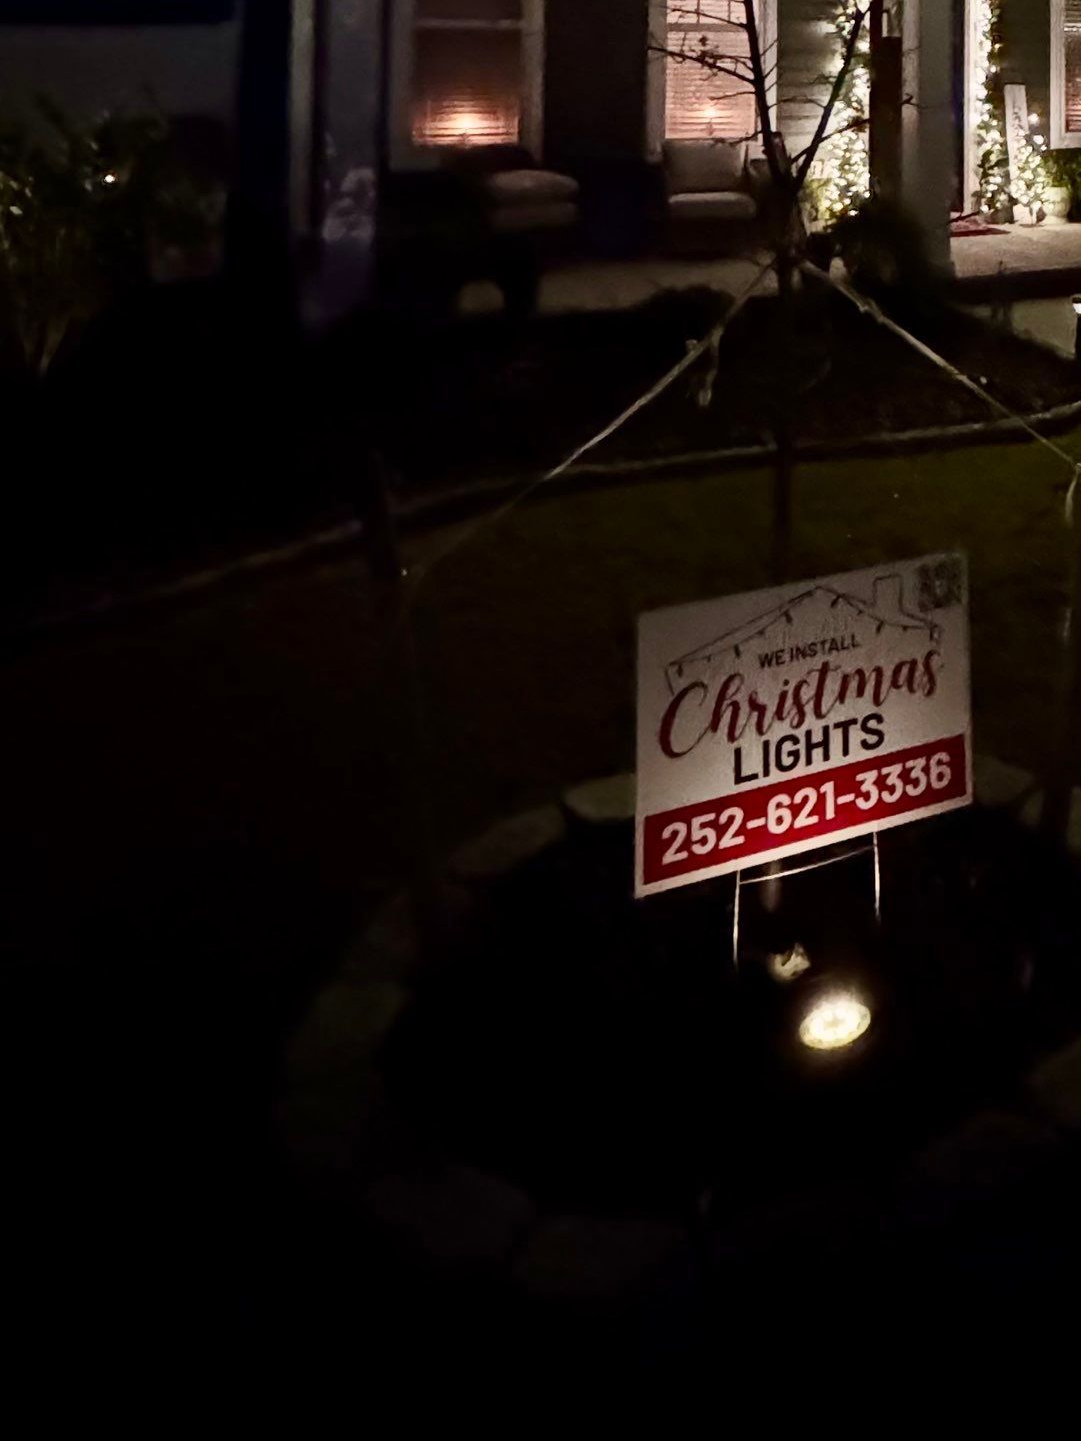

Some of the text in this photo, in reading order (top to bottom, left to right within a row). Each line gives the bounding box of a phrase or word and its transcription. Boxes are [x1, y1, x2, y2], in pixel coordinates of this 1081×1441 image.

[759, 635, 861, 668] WE INSTALL
[660, 650, 941, 757] Christmas
[735, 714, 885, 784] LIGHTS
[662, 753, 952, 864] 252-621-3336
